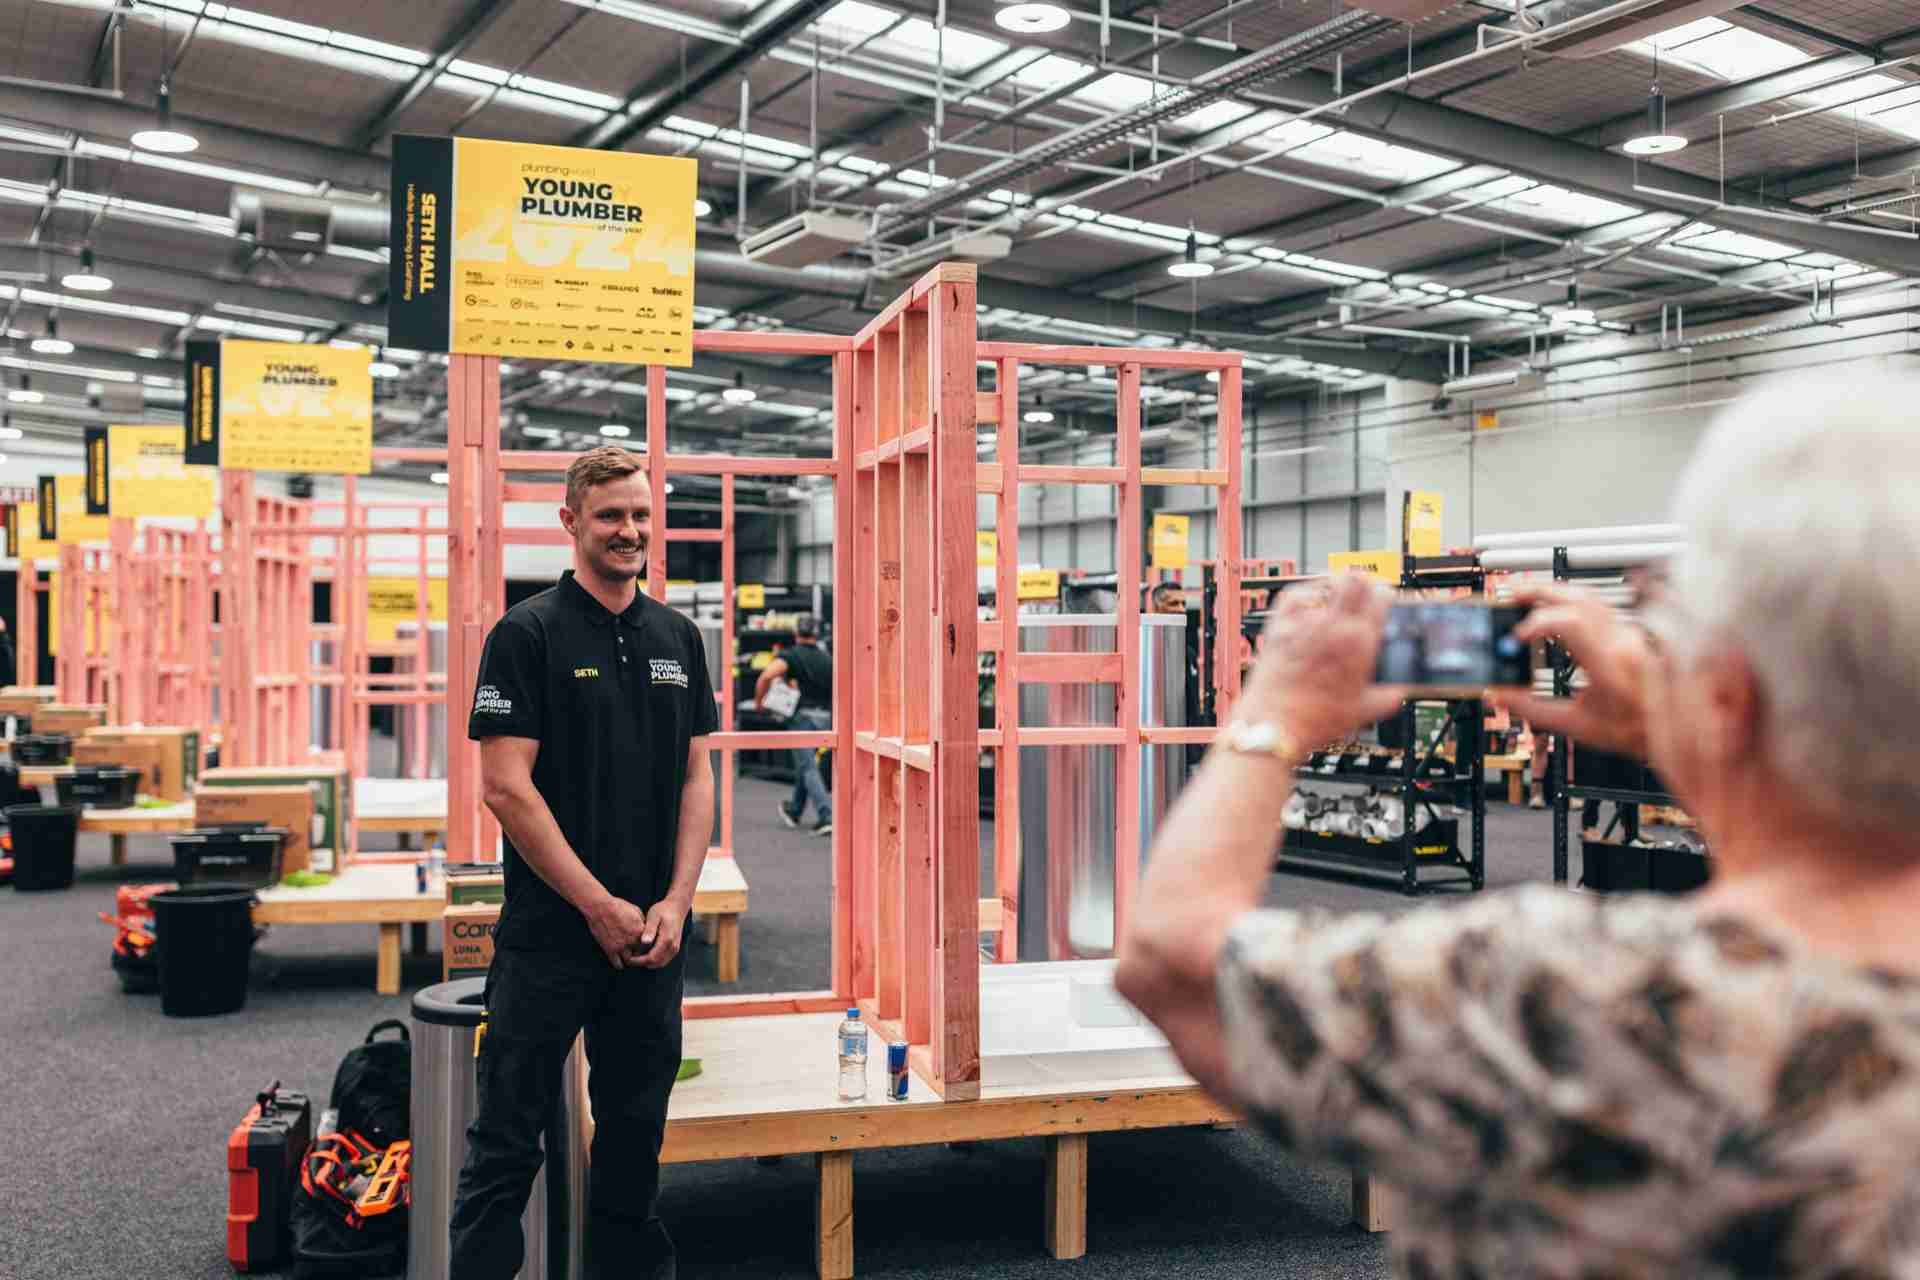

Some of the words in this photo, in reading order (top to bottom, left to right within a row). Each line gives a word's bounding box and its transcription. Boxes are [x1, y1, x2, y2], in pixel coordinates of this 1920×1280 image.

[522, 177, 612, 201] YOUNG
[420, 193, 437, 240] SETH
[521, 198, 643, 223] PLUMBER
[608, 224, 622, 232] the
[624, 226, 643, 235] year
[419, 245, 435, 294] HALL
[574, 667, 599, 678] SETH
[650, 663, 682, 673] YOUNG
